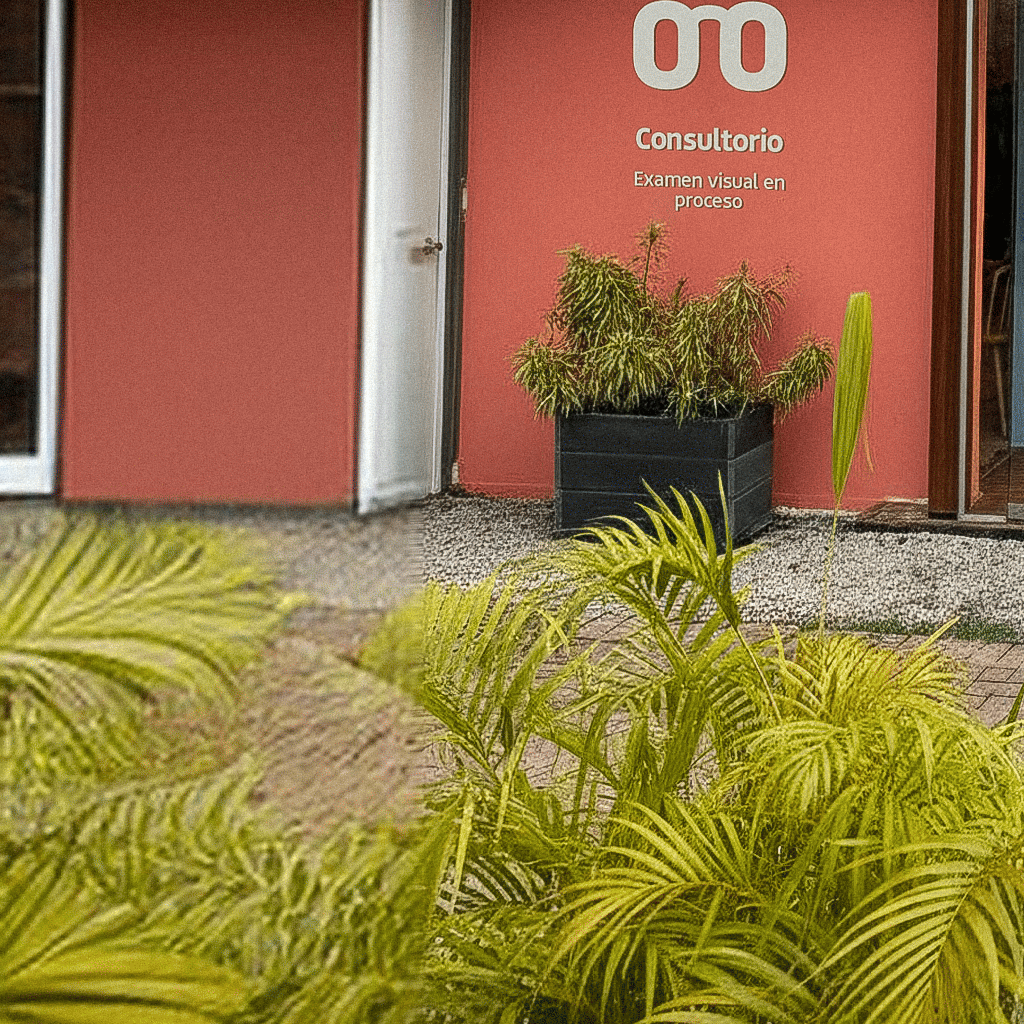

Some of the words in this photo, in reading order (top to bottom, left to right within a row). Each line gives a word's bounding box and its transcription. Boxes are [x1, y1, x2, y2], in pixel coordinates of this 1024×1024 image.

[635, 127, 784, 153] Consultorio
[634, 171, 703, 188] Examen
[707, 171, 759, 190] visual
[763, 176, 786, 191] en
[675, 193, 744, 212] proceso
